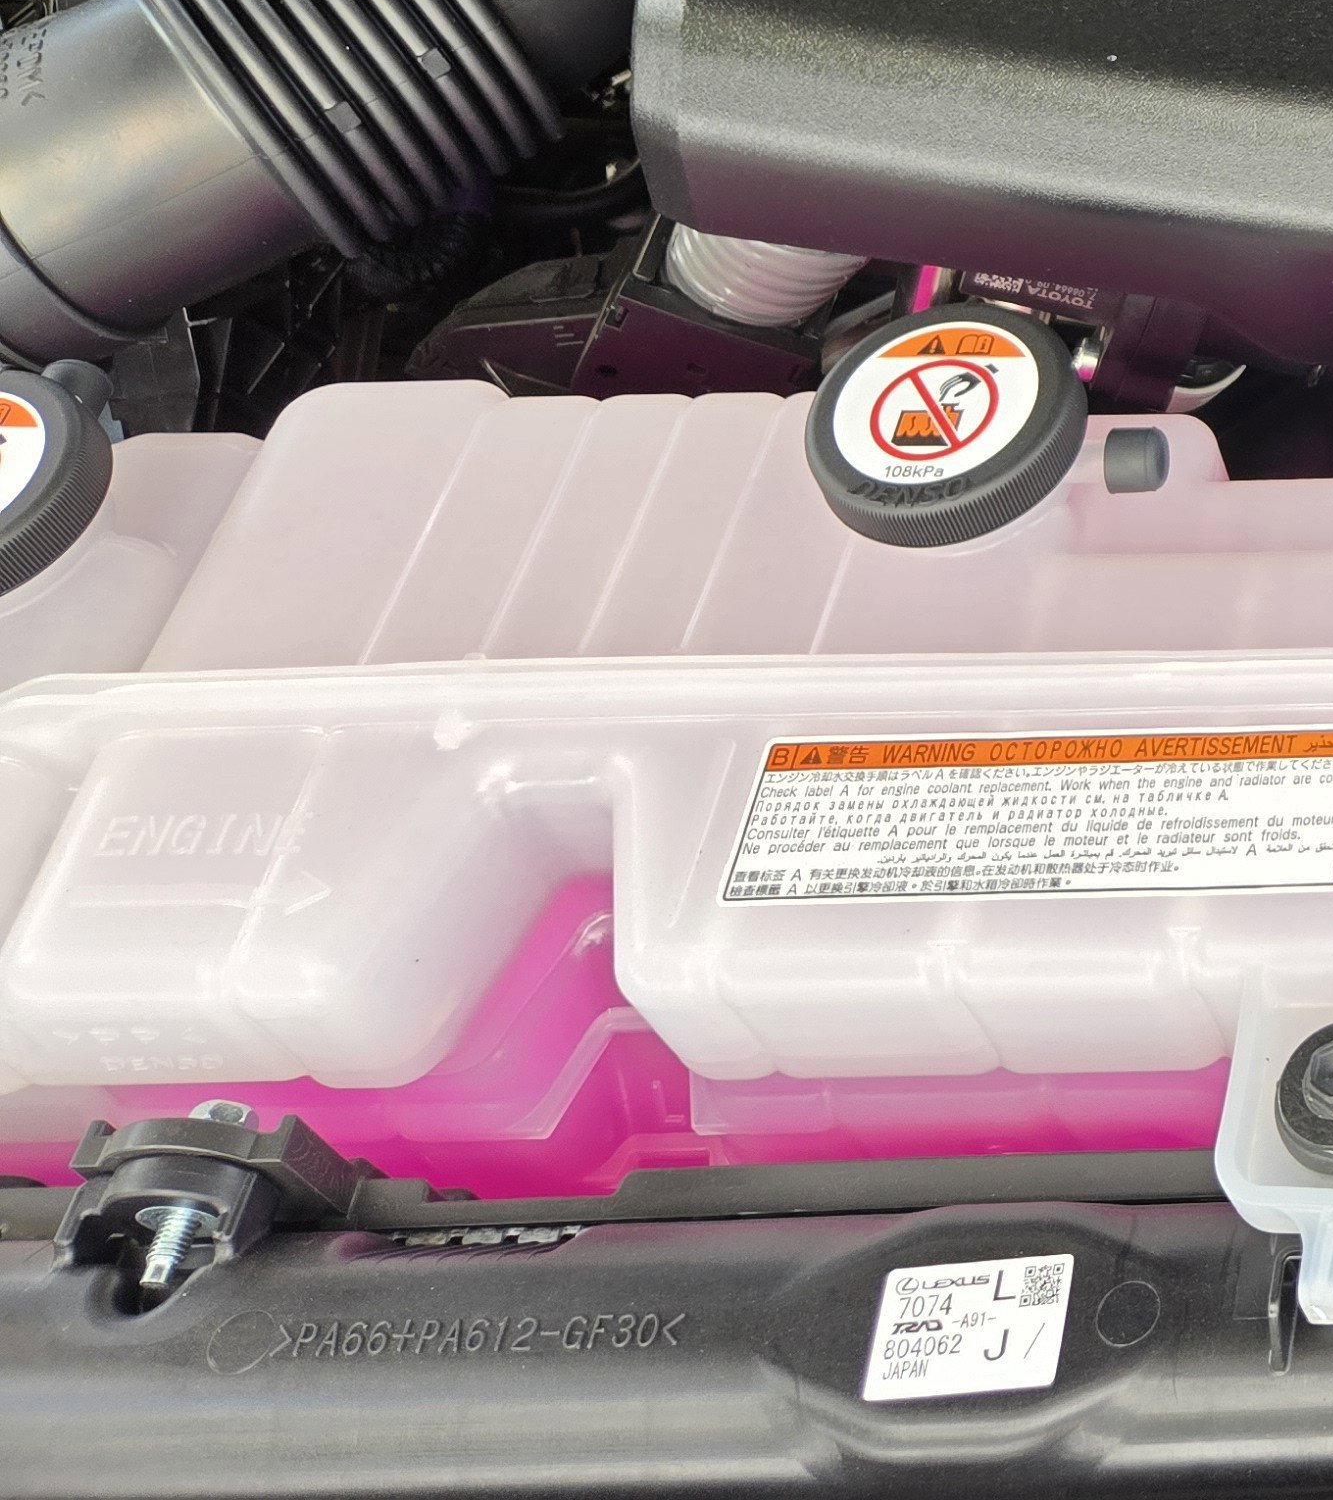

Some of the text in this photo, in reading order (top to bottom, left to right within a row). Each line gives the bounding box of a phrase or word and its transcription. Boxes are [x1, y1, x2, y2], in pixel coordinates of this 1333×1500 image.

[1027, 285, 1094, 310] TOYOTA
[884, 465, 945, 479] 108kPa
[847, 477, 972, 508] DENSO
[770, 748, 790, 767] B
[825, 745, 870, 765] 警告
[879, 742, 977, 765] WARNING
[989, 738, 1123, 762] ОСТОРОЖНО
[1133, 734, 1299, 758] AVERTISSEMENT
[760, 786, 798, 799] Check
[804, 784, 834, 798] label
[839, 784, 849, 797] A
[857, 784, 875, 797] for
[880, 783, 920, 797] engine
[927, 782, 972, 794] coolant
[978, 780, 1052, 794] replacement.
[1060, 778, 1092, 791] Work
[1099, 778, 1130, 791] when
[1137, 777, 1156, 789] the
[1162, 776, 1203, 791] engine
[1209, 775, 1233, 788] and
[1236, 773, 1286, 787] radiator
[1292, 775, 1312, 785] are
[934, 768, 944, 781] A
[754, 799, 821, 813] Порядок
[828, 799, 885, 811] замены
[891, 794, 995, 810] охлаждающей
[1001, 795, 1077, 807] жидкости
[1085, 794, 1106, 805] см.
[1112, 793, 1130, 804] на
[1139, 789, 1212, 803] табличке
[747, 827, 811, 841] Consulter
[817, 823, 880, 840] l'étiquette
[887, 824, 898, 837] A
[906, 825, 938, 838] pour
[944, 823, 957, 836] le
[964, 821, 1053, 836] remplacement
[1061, 820, 1078, 833] du
[1085, 819, 1129, 833] liquide
[1136, 818, 1153, 831] de
[1160, 816, 1259, 830] refroidissement
[1267, 815, 1284, 830] du
[750, 806, 1168, 827] Работайте, когда двигатель и радиатор холодные.
[97, 812, 307, 859] ENGINE
[741, 828, 1301, 856] Ne procéder au remplacement que lorsque le moteur et le radiateur sont froids.
[790, 868, 802, 882] A
[786, 883, 797, 896] A
[921, 1270, 1017, 1302] LEXUS L
[899, 1293, 953, 1320] 7074
[884, 1329, 1010, 1361] 804062 J
[883, 1360, 930, 1381] JAPAN
